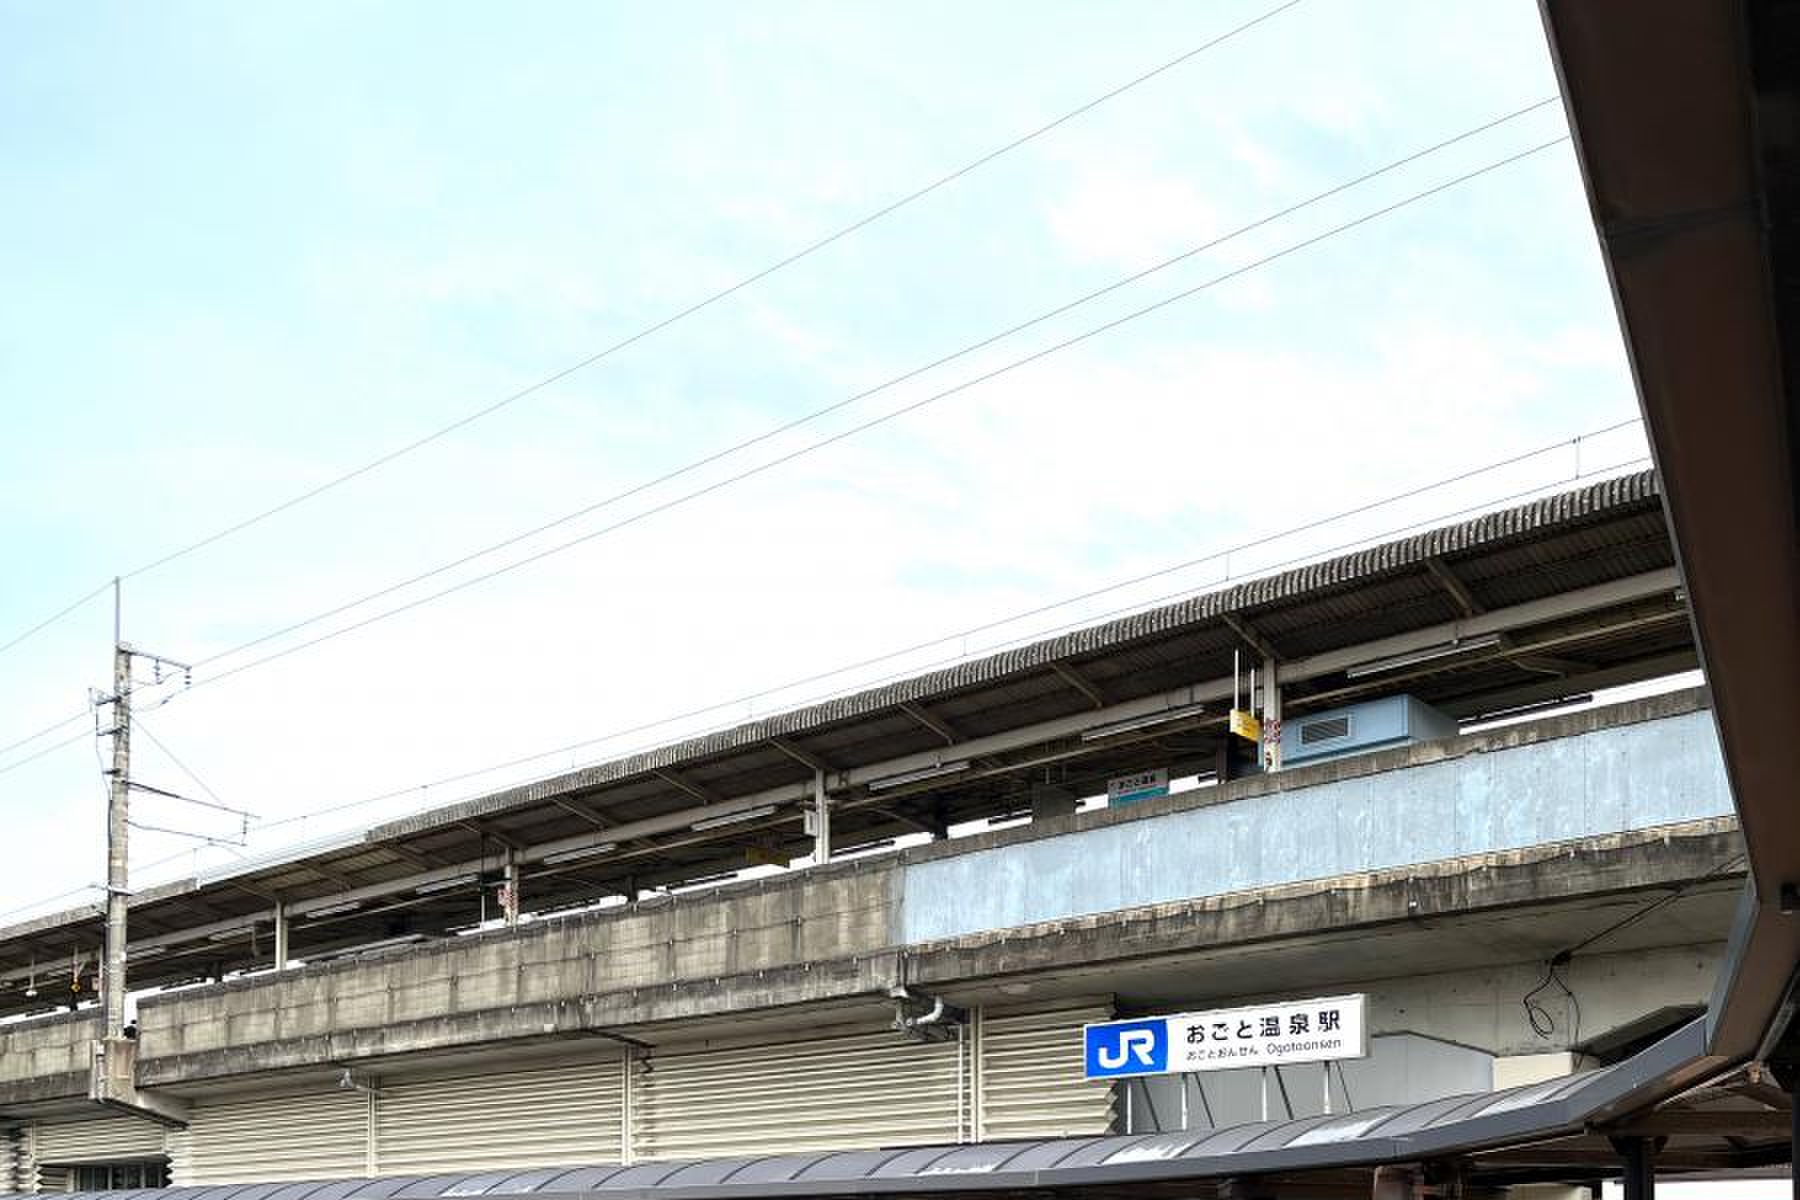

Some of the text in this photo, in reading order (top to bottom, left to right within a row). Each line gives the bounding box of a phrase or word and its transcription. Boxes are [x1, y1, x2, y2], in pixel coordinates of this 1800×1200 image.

[1186, 1009, 1340, 1044] おごと温泉駅
[1098, 1028, 1156, 1069] JR
